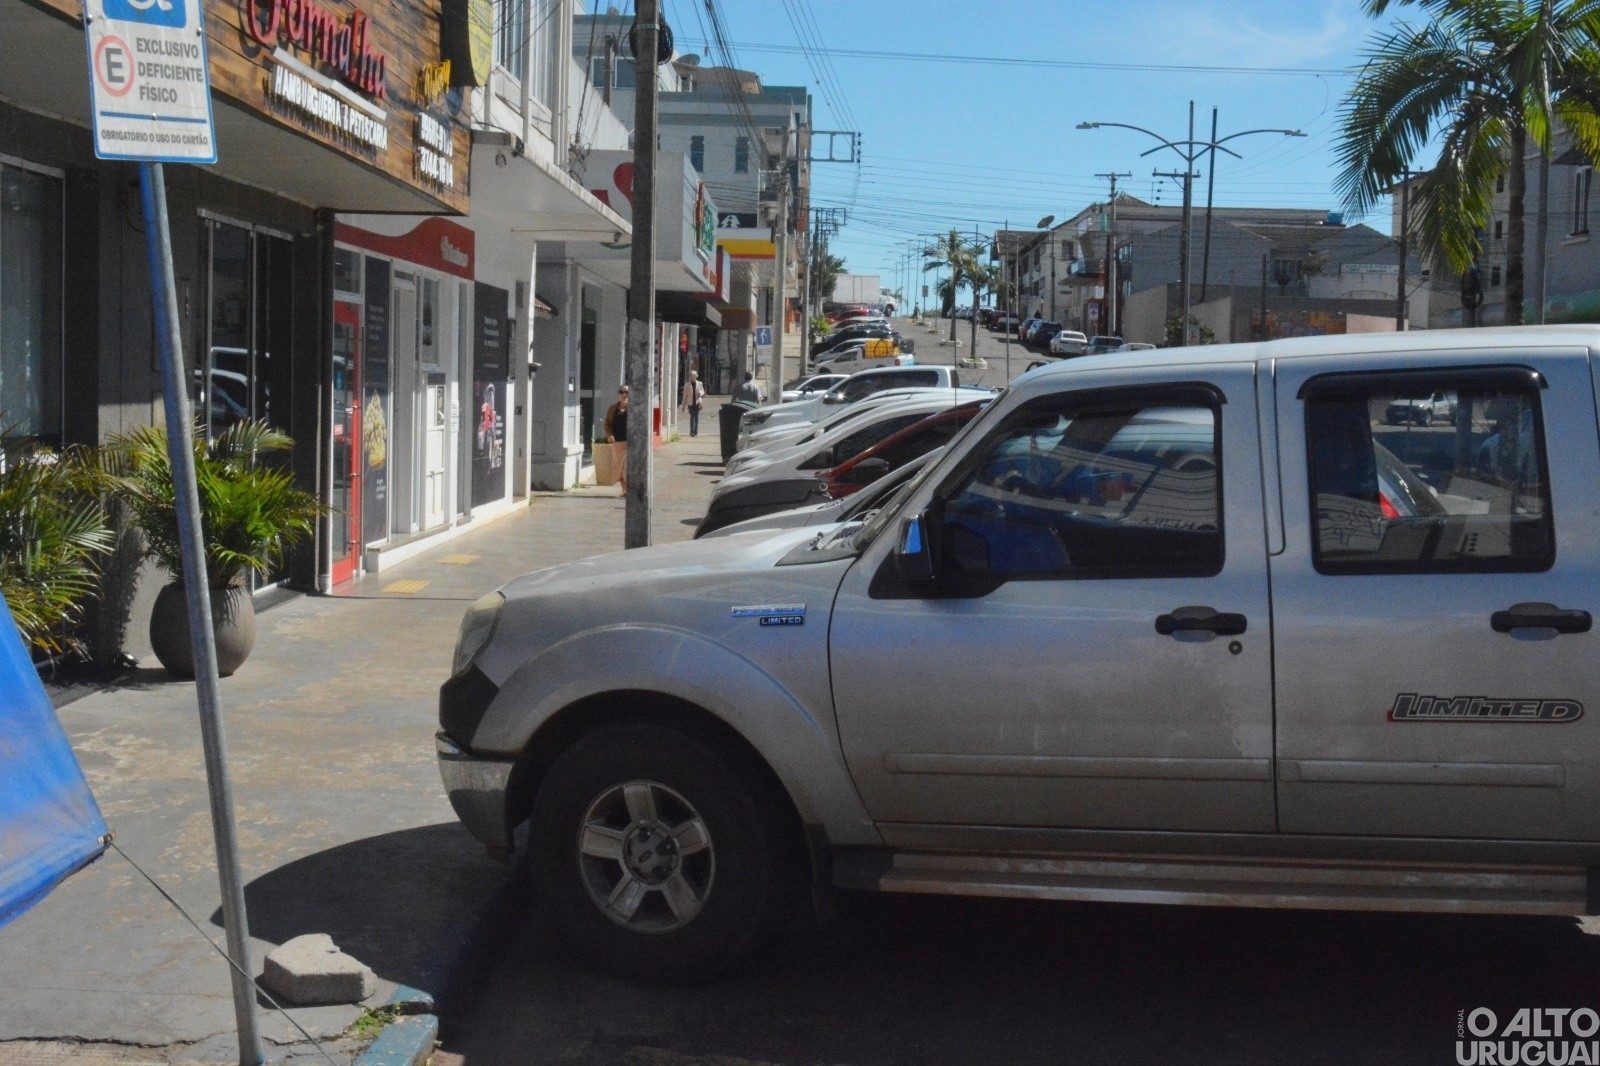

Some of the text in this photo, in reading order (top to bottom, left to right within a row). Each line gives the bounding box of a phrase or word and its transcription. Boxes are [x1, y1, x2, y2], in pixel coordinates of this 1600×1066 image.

[136, 37, 199, 59] EXCLUSIVO
[105, 47, 124, 83] E
[138, 61, 203, 83] DEFICIENTE
[139, 83, 177, 103] FÍSICO
[275, 65, 341, 127] HAMBURGUERIA
[101, 129, 208, 145] OBRIGATÓRIO O USO DO CARTÃO
[761, 616, 803, 625] LIMITED
[1392, 692, 1584, 723] LIMITED
